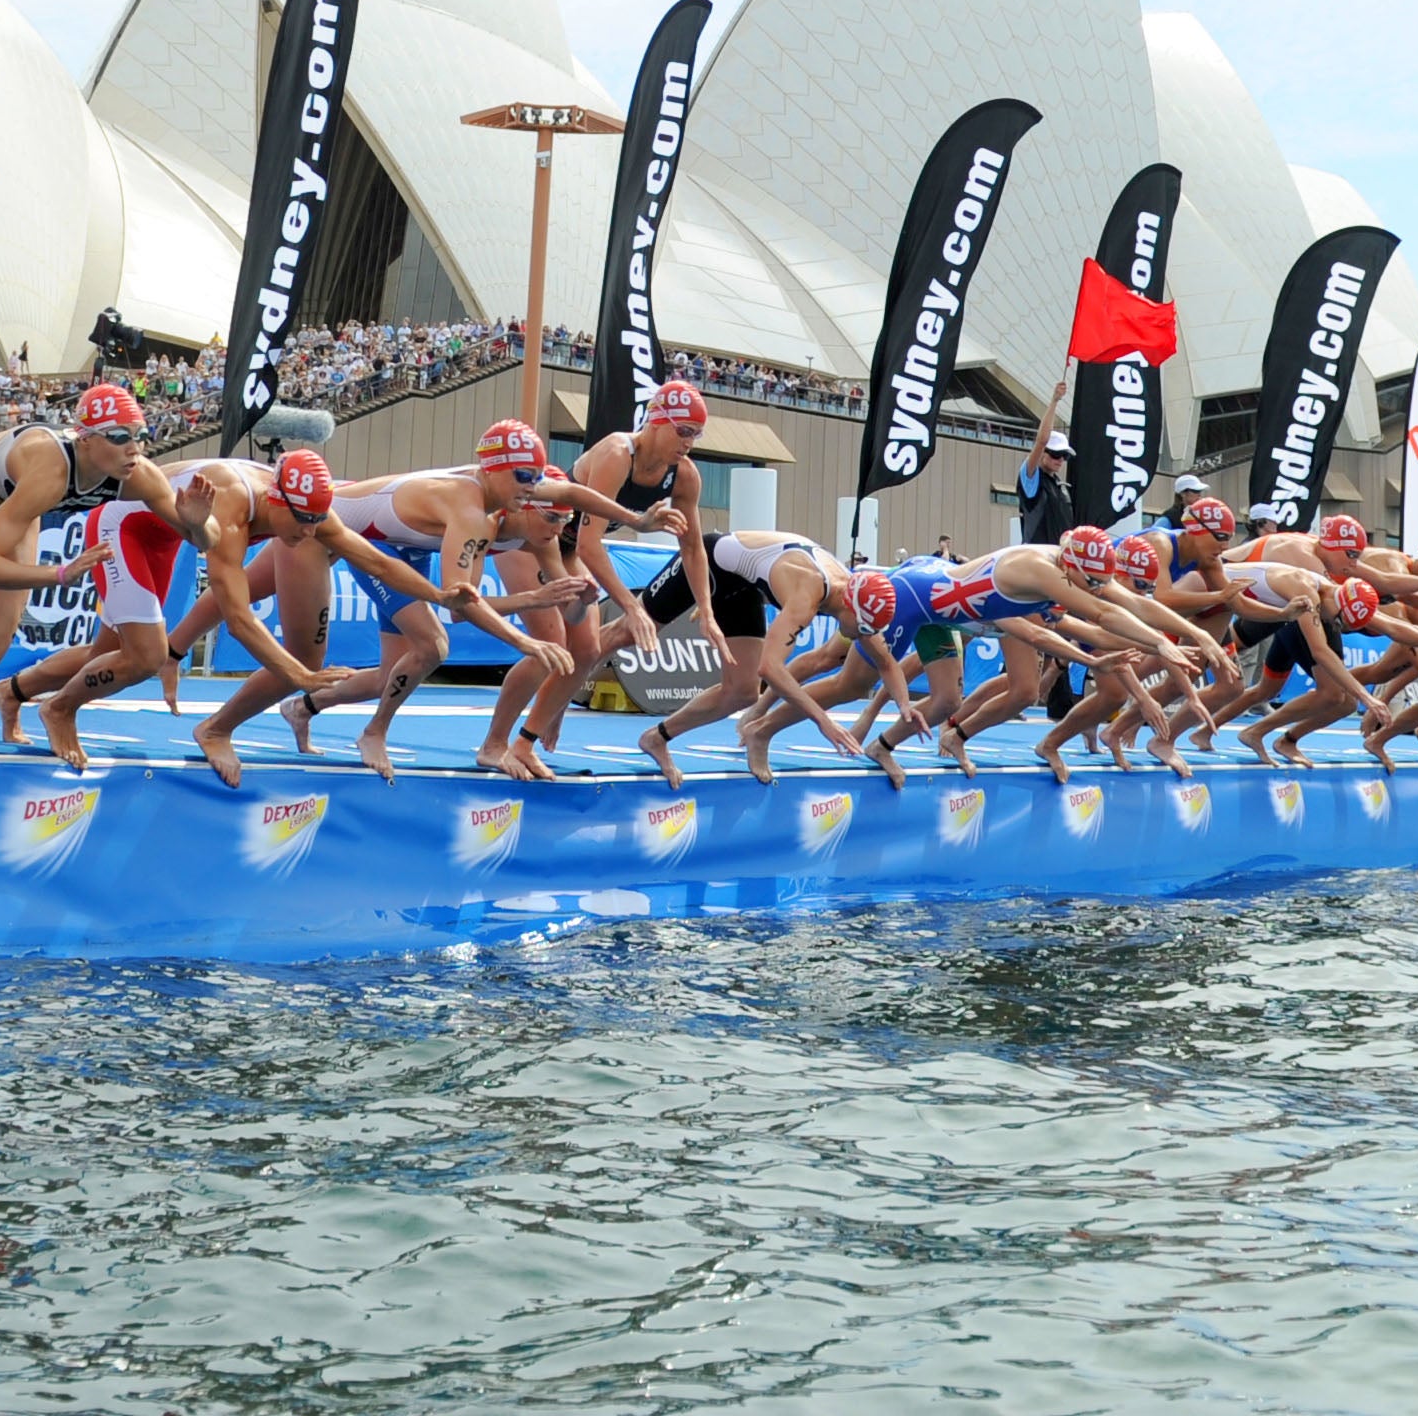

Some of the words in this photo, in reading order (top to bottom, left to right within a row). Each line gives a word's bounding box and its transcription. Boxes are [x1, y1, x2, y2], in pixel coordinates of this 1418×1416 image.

[883, 146, 1005, 477] sydney.com
[667, 390, 692, 406] 66
[1270, 261, 1366, 527] sydney.com
[91, 396, 119, 420] 32
[507, 431, 535, 450] 65
[285, 468, 314, 494] 38
[1203, 506, 1224, 520] 58
[1339, 523, 1359, 537] 64
[1087, 540, 1108, 559] 07
[1131, 551, 1150, 567] 45
[863, 594, 886, 614] 17
[1350, 600, 1369, 622] 60
[23, 791, 84, 820] DEXTRO
[263, 798, 316, 825] DEXTRO
[471, 802, 511, 826] DEXTRO
[648, 802, 686, 825] DEXTRO
[811, 795, 843, 818] DEXTRO
